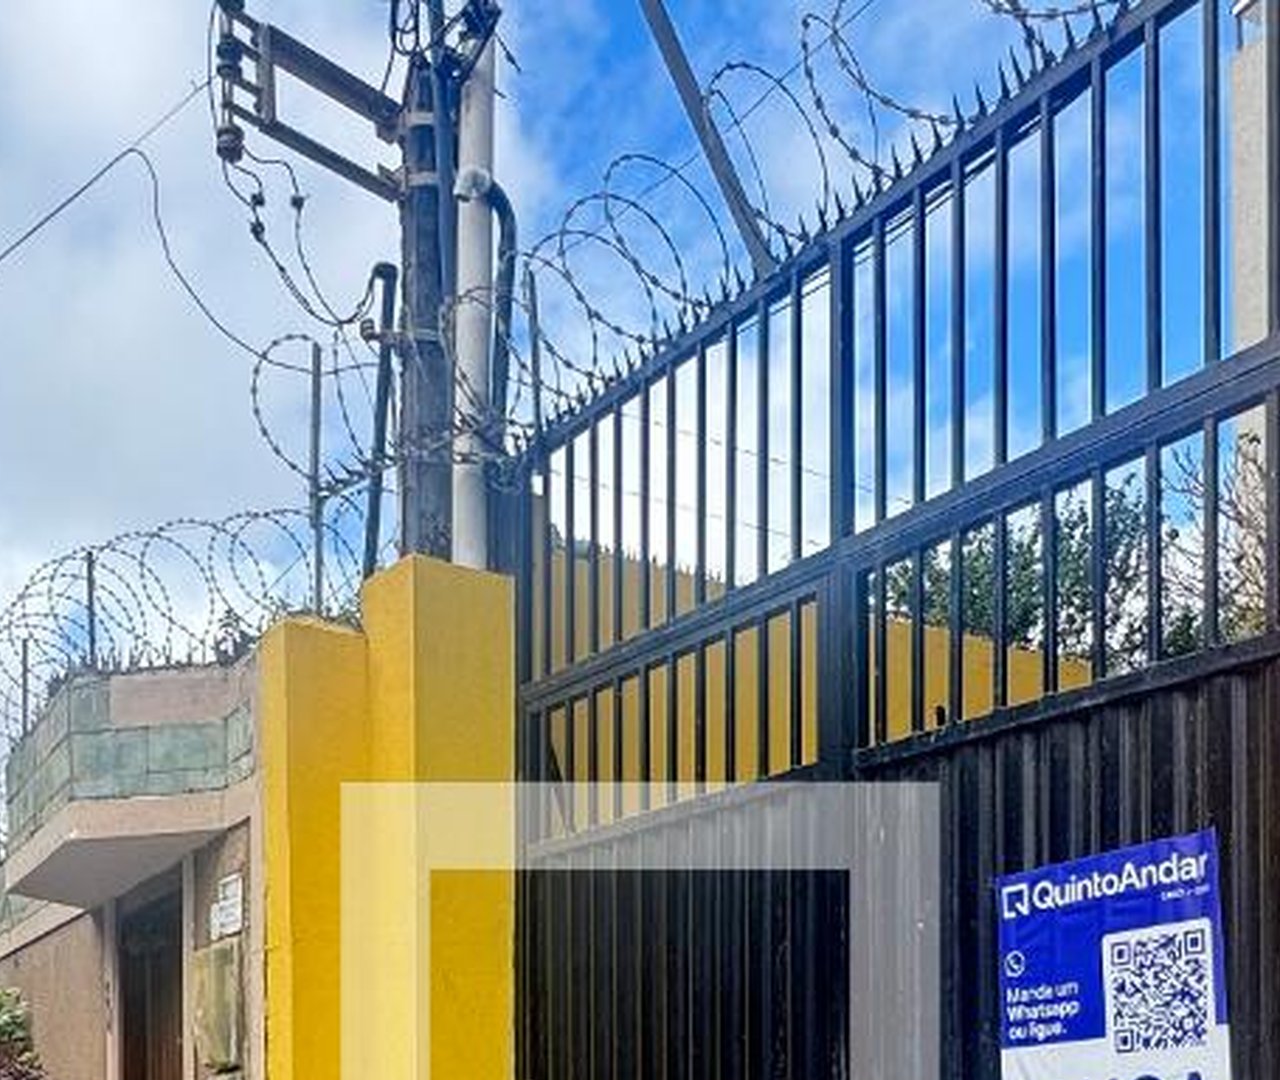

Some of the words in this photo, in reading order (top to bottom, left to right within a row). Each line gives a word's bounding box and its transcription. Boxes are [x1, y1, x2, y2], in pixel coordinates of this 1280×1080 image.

[1032, 852, 1208, 910] QuintoAndar
[1006, 985, 1053, 1003] Mande
[1055, 981, 1079, 997] um
[1009, 1026, 1028, 1040] ou
